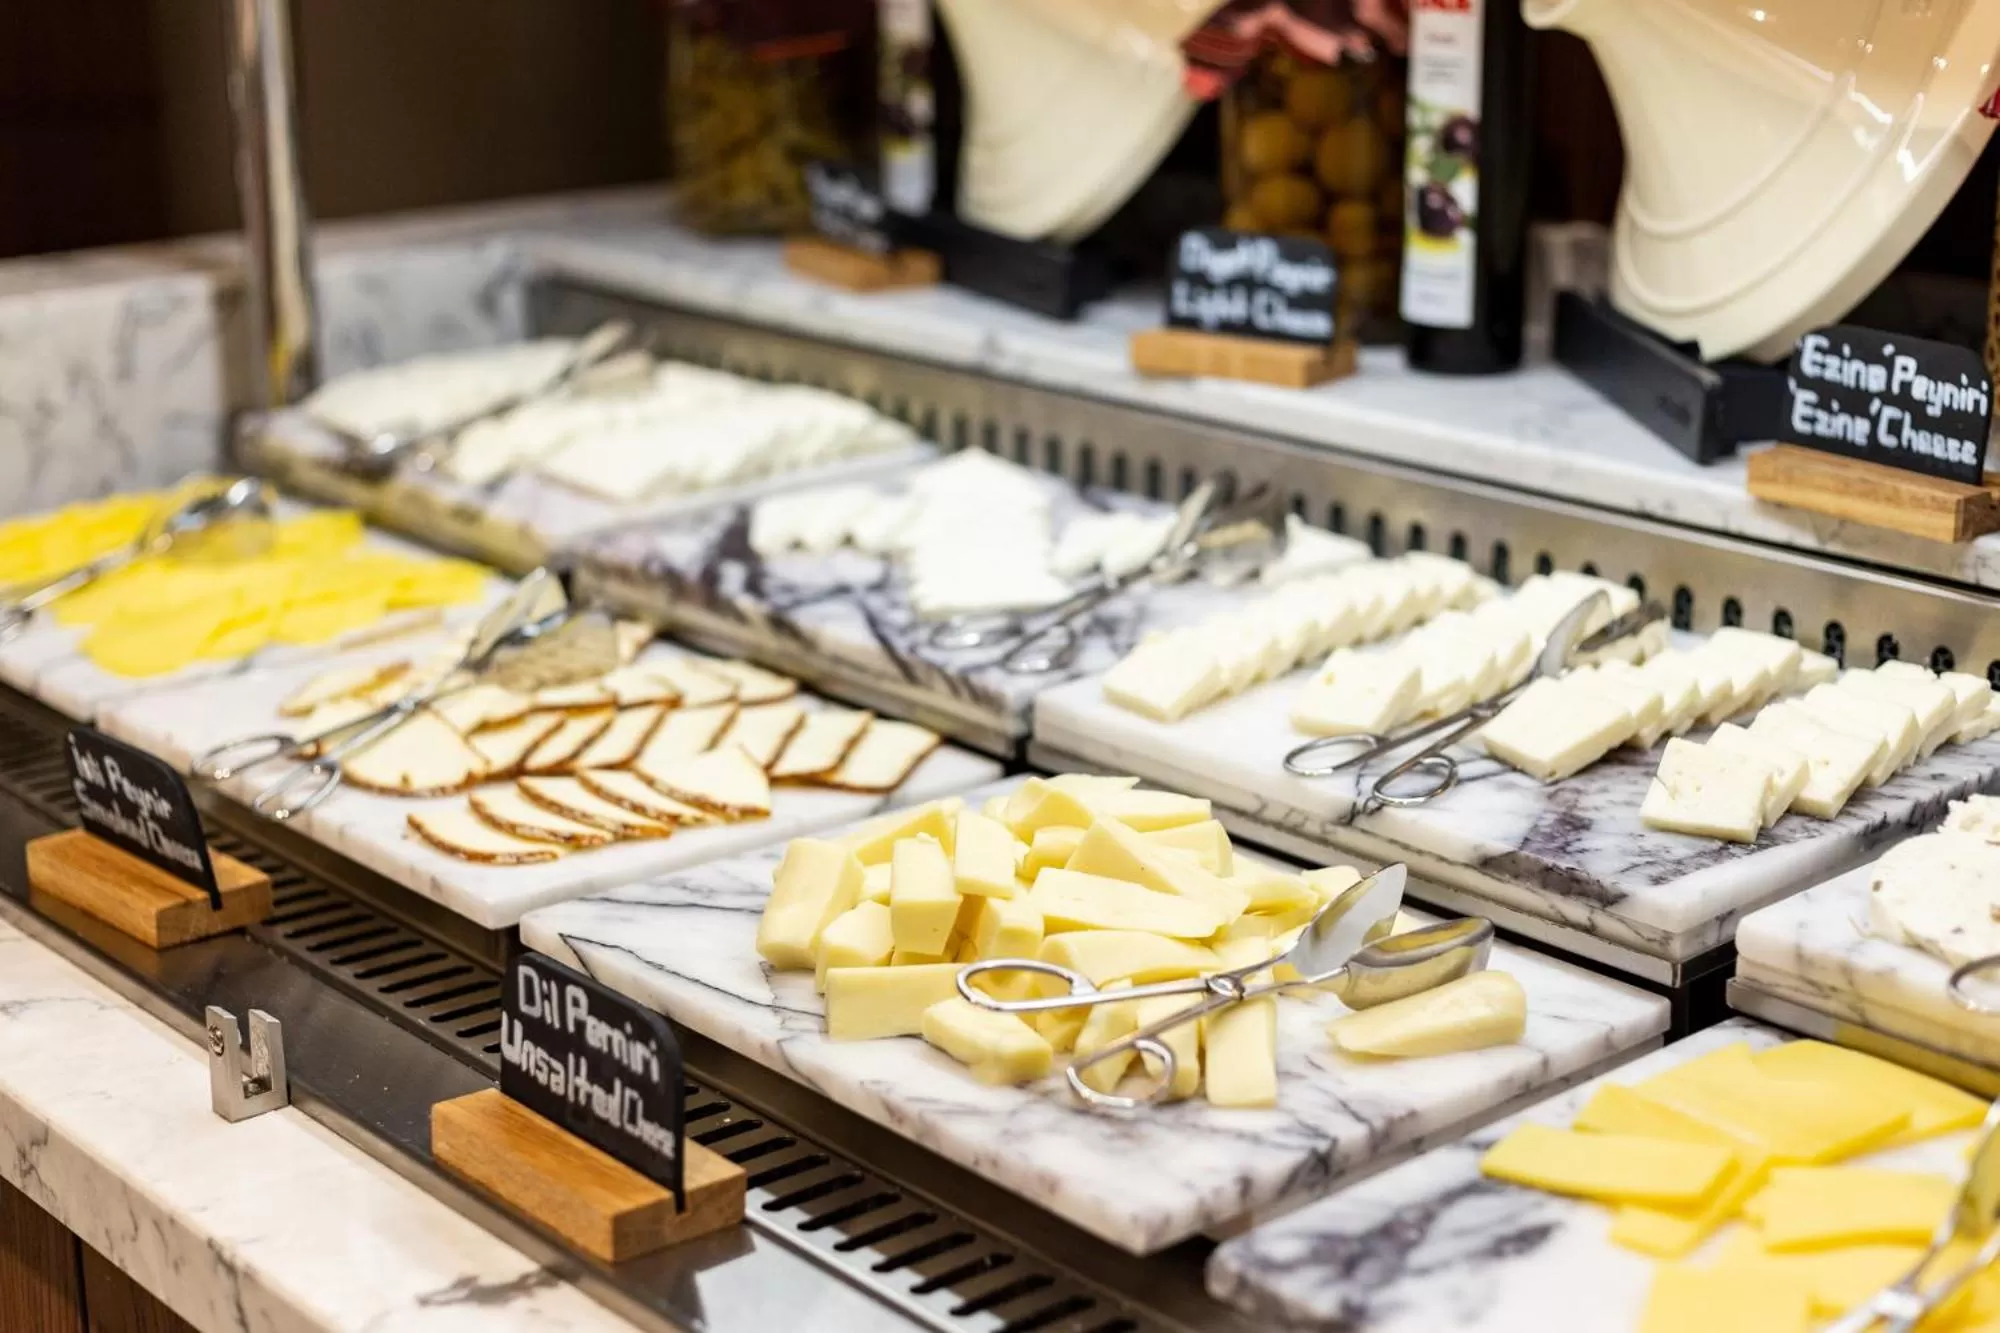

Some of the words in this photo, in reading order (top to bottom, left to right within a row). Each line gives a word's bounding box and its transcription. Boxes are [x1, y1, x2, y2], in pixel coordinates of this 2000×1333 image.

[1891, 355, 1989, 417] Peyniri
[517, 964, 561, 1030] Dil
[501, 1010, 621, 1128] Unsalted
